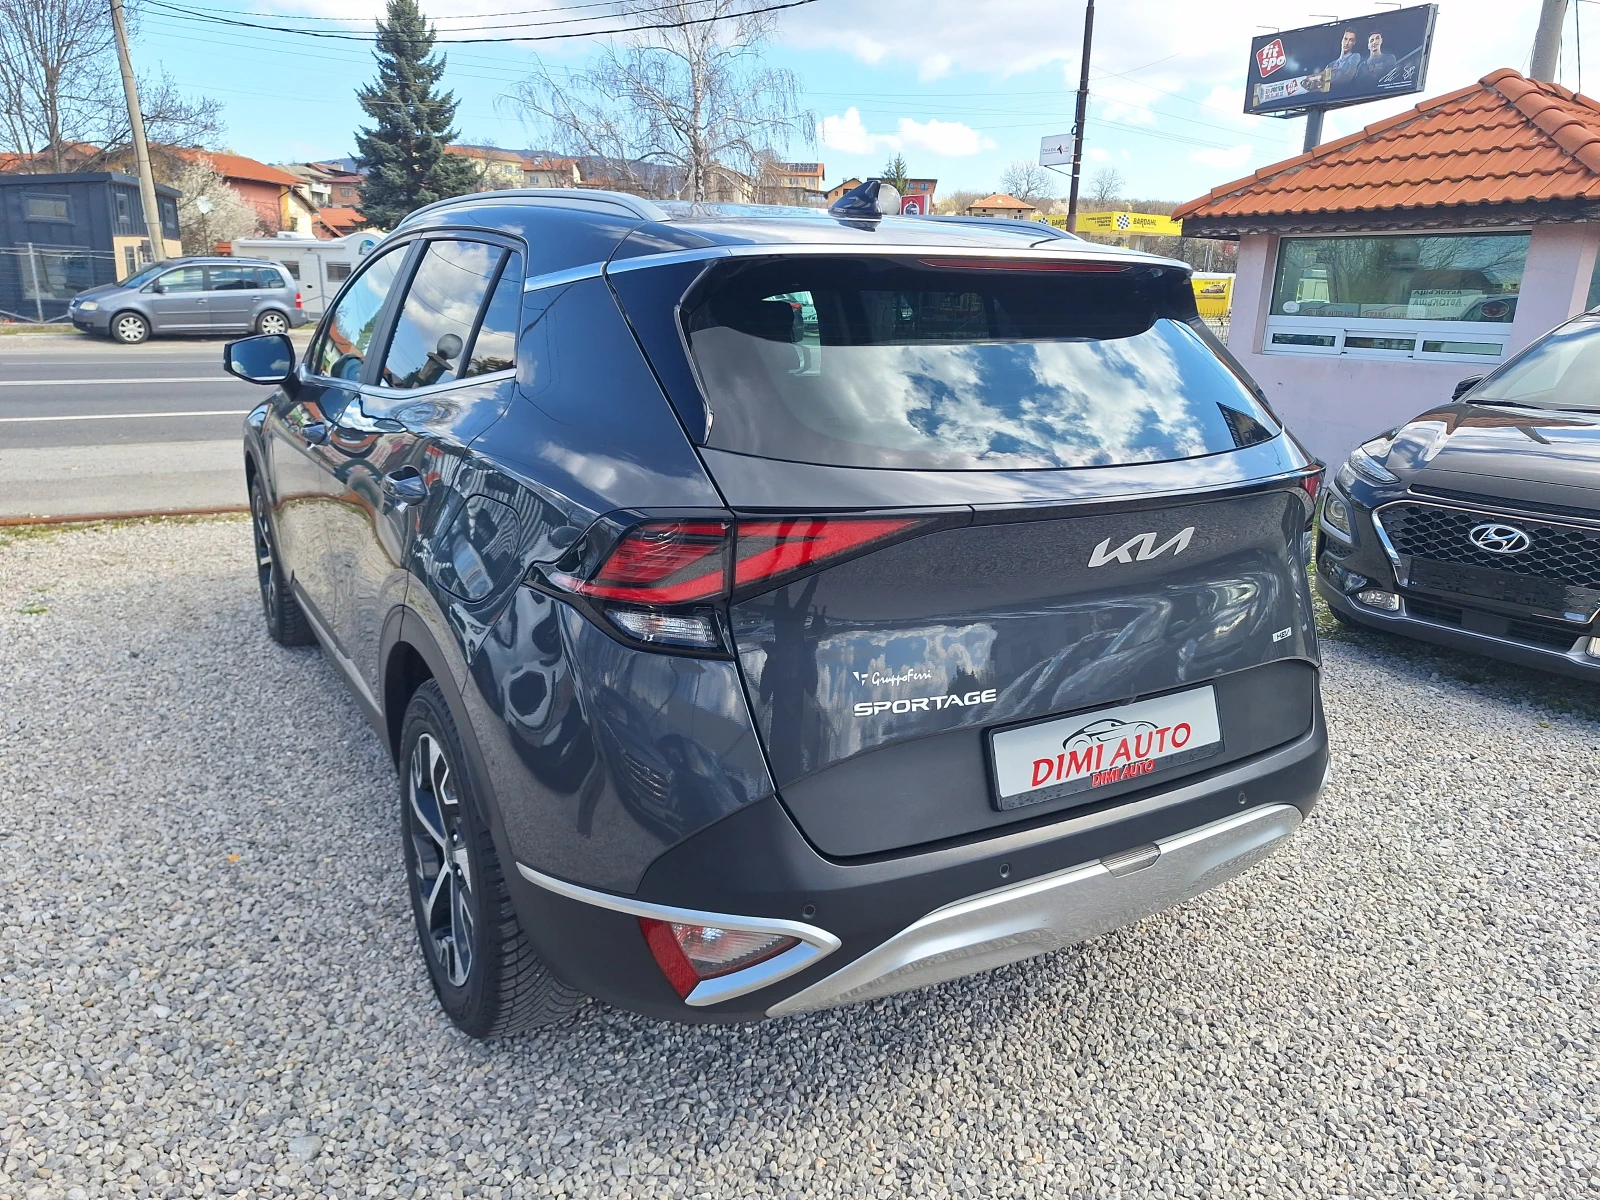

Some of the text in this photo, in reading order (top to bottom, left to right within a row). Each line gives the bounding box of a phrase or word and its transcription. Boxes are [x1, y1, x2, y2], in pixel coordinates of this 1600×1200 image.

[1262, 44, 1279, 58] fit
[1261, 56, 1285, 71] spo
[1133, 218, 1157, 228] BARDAHL
[1088, 527, 1195, 567] KIA
[1277, 629, 1290, 640] HEV
[854, 688, 997, 717] SPORTAGE
[1031, 722, 1191, 787] DIMI AUTO
[1092, 759, 1156, 787] DIMI AUTO
